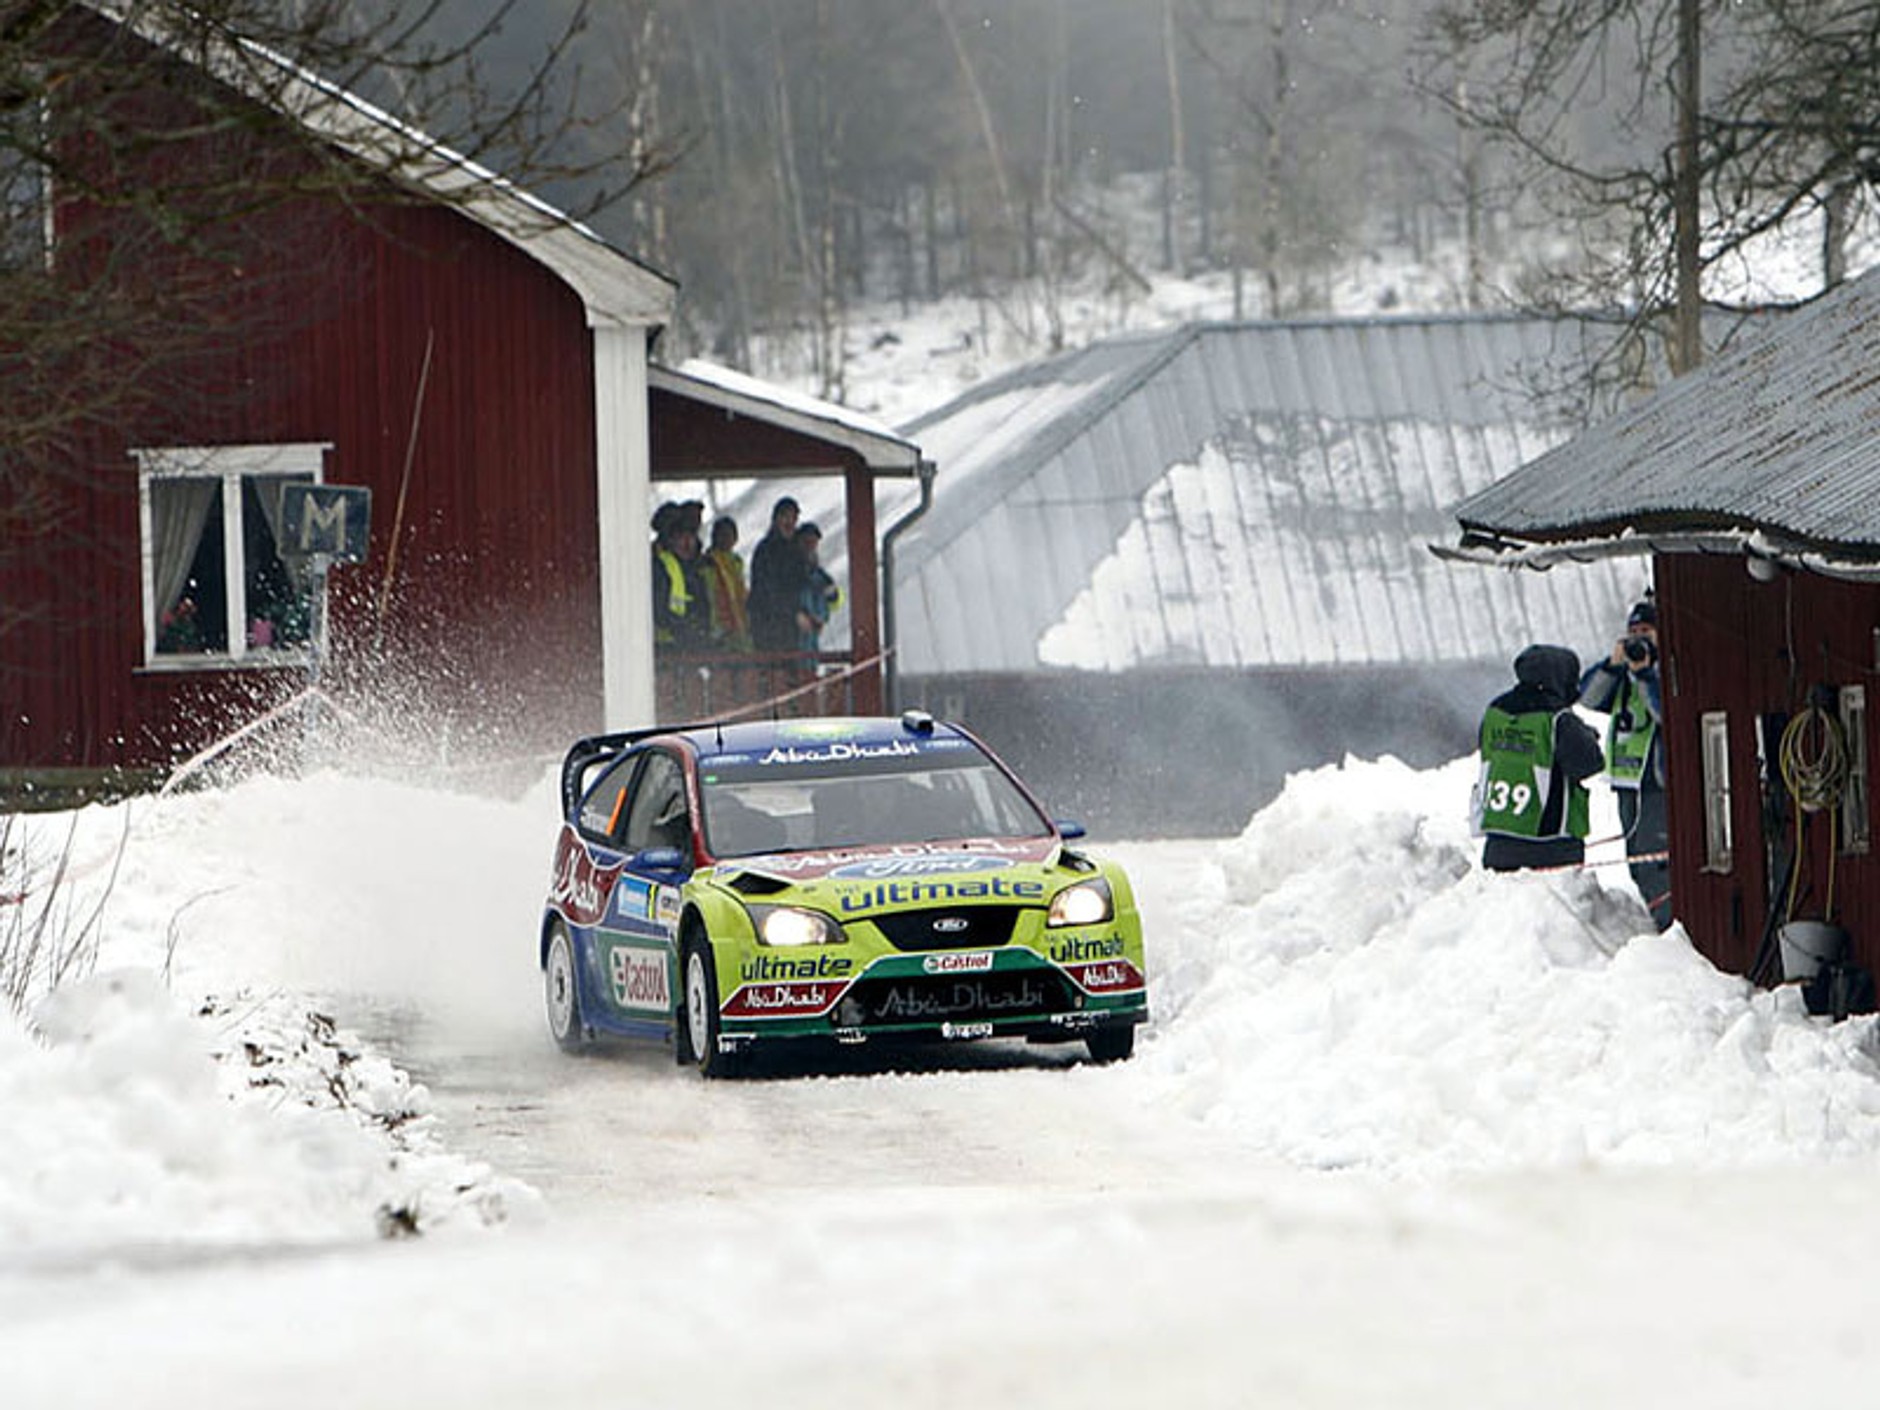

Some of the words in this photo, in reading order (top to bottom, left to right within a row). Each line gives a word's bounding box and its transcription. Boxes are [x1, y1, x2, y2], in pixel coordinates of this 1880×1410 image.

[301, 491, 346, 551] M
[1485, 779, 1531, 815] 39
[841, 877, 1043, 912] ultimate
[741, 954, 852, 981] ultimate
[942, 954, 988, 970] Castrol
[874, 986, 945, 1017] Abu
[953, 978, 1044, 1012] Dhabi
